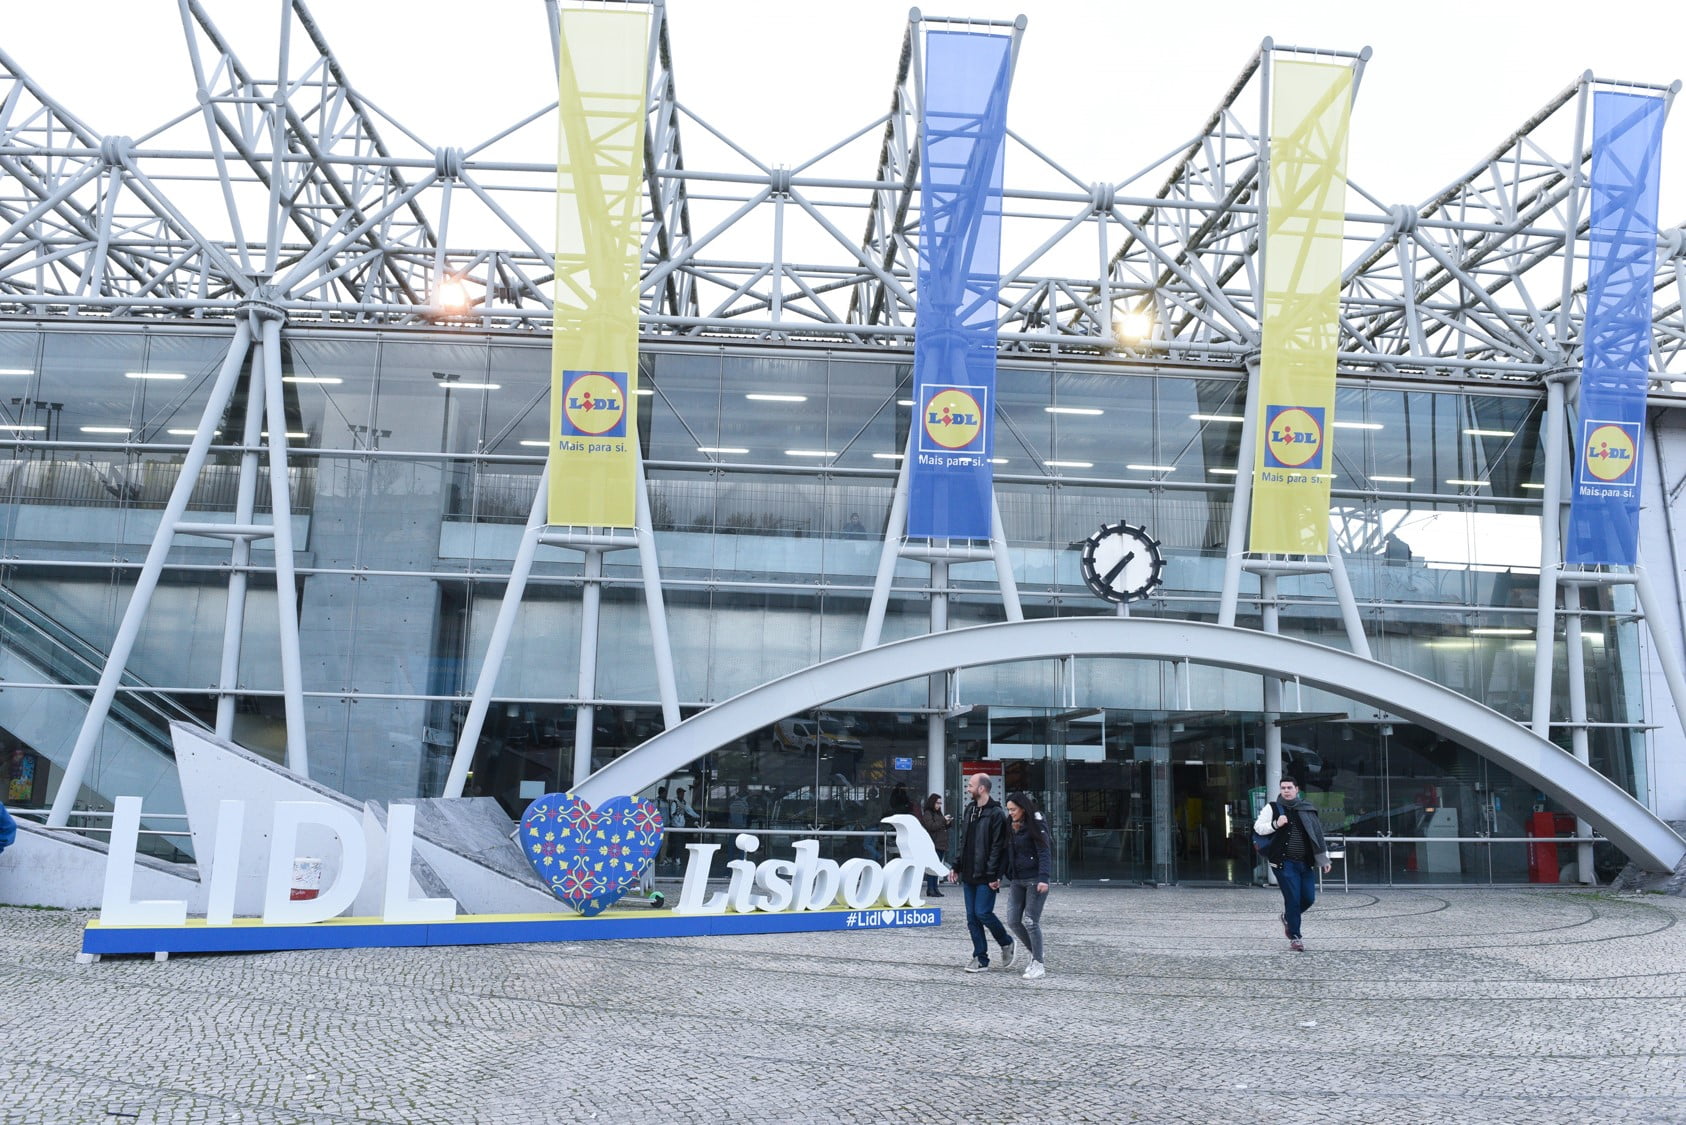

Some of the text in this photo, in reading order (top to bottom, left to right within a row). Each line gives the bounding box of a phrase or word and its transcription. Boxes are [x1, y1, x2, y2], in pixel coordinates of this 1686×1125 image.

[560, 441, 584, 451] Mais
[588, 443, 612, 453] para
[919, 455, 943, 465] Mais
[946, 457, 970, 467] para
[1262, 472, 1284, 482] Mais
[1287, 474, 1307, 484] para
[1580, 486, 1599, 496] Mais
[1601, 489, 1620, 498] para
[99, 796, 456, 925] LIDL
[672, 815, 948, 914] Lisboa
